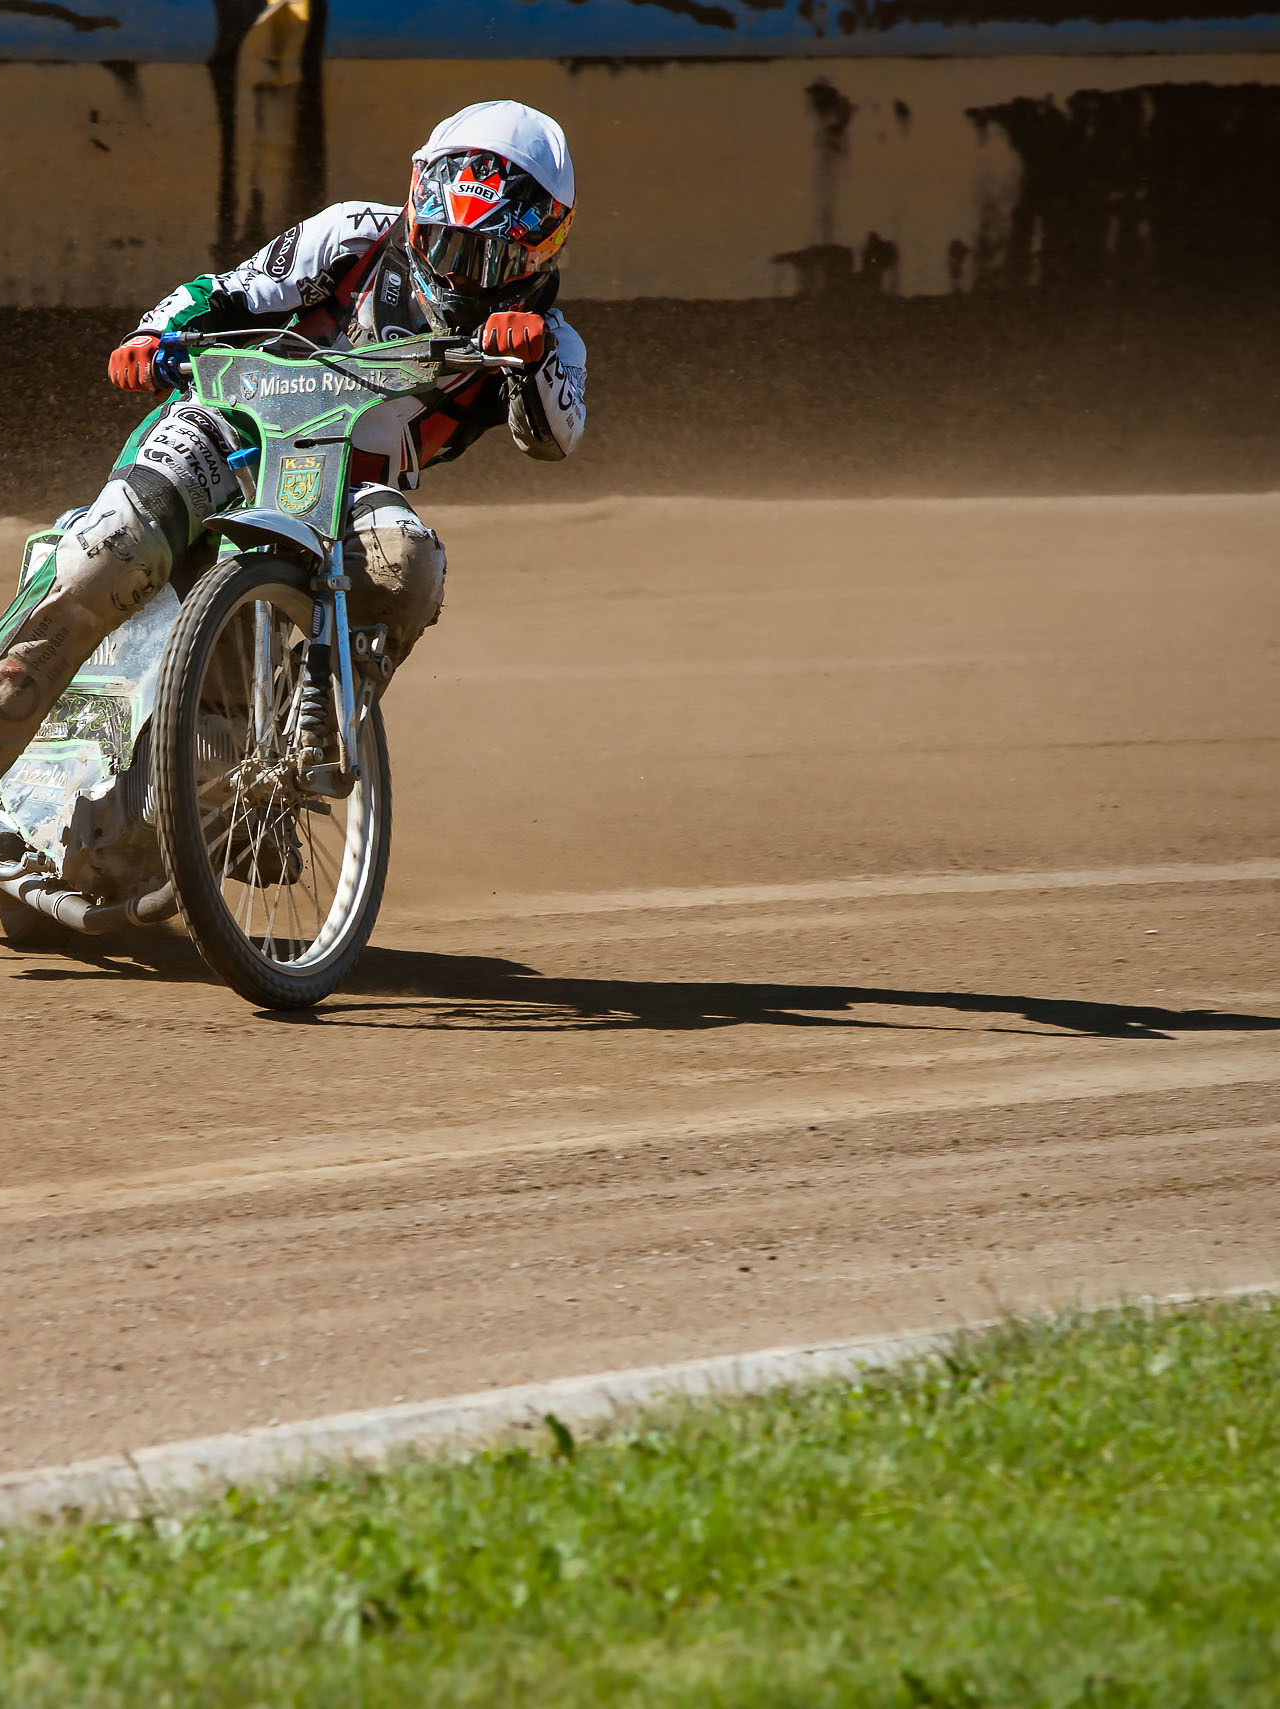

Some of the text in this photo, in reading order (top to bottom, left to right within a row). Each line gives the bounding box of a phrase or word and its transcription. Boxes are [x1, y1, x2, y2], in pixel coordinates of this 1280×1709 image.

[459, 184, 495, 201] SHOEI
[259, 374, 317, 397] Miasto
[176, 427, 221, 485] SPORTLAND
[312, 604, 321, 635] HAGON
